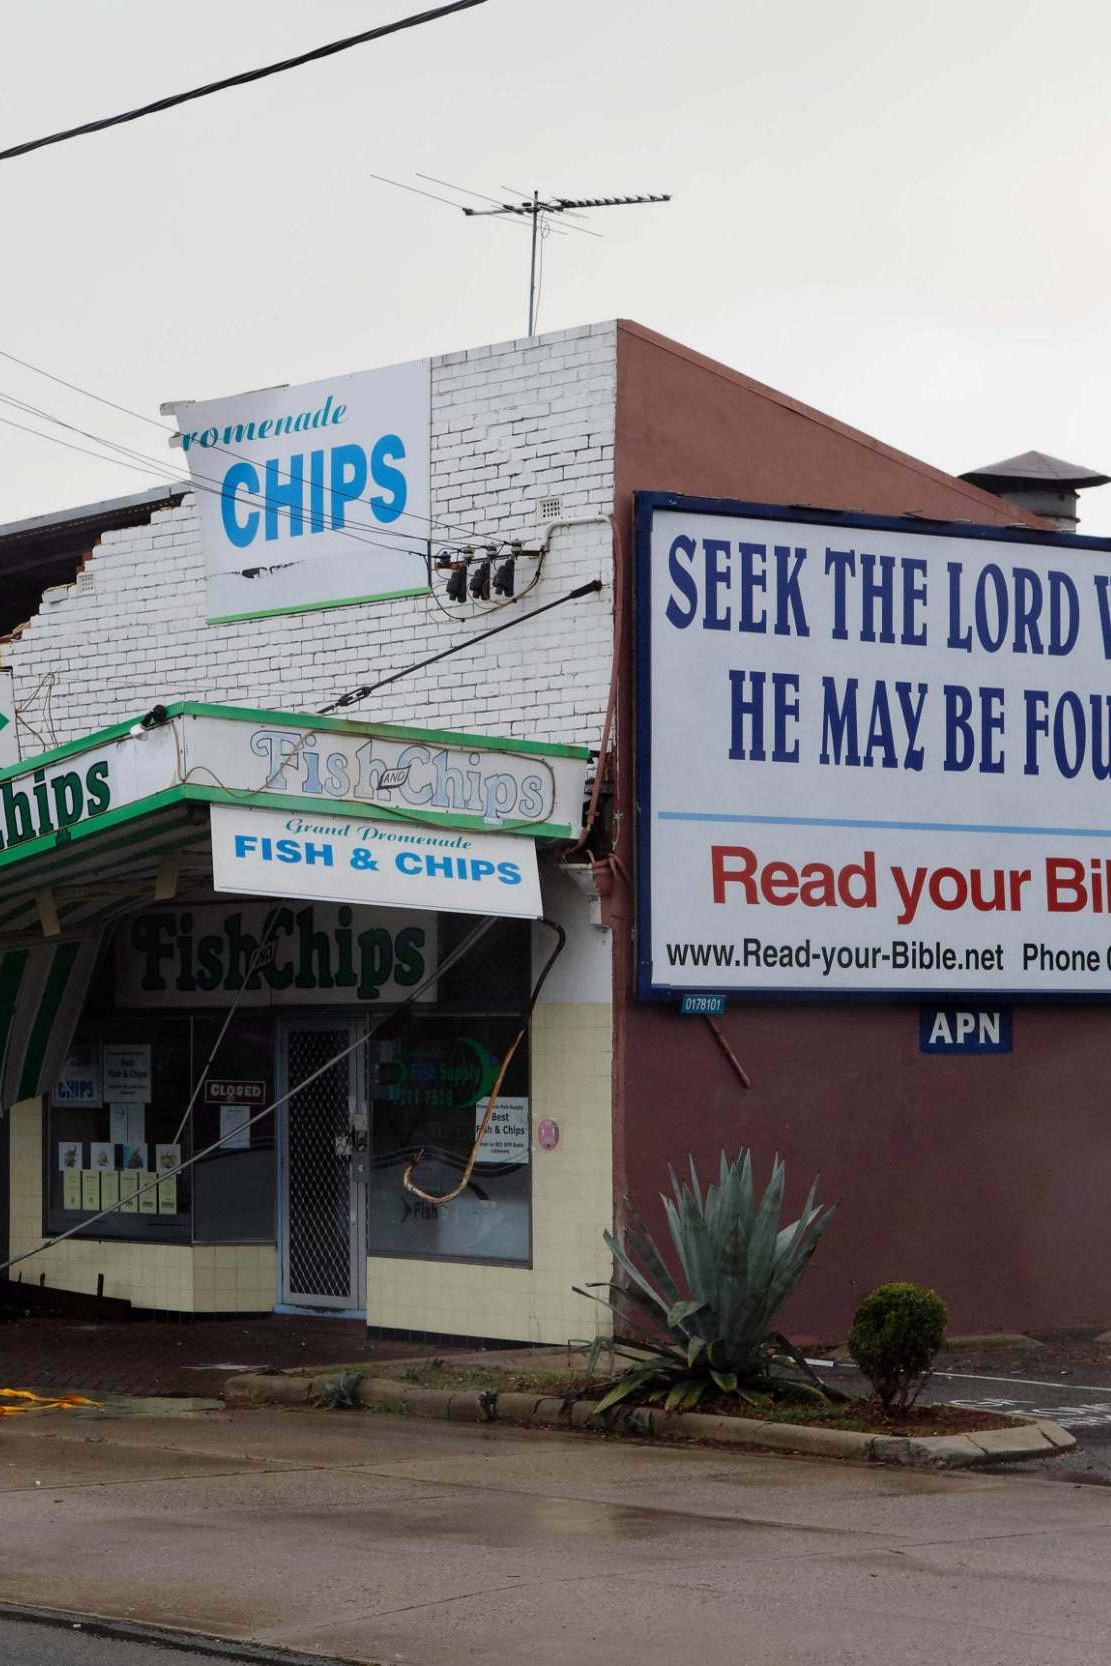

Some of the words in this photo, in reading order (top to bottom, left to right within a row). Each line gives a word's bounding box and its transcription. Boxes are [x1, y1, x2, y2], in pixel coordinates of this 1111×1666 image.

[221, 433, 408, 548] CHIPS
[665, 534, 810, 638] SEEK
[824, 547, 928, 647] THE
[946, 561, 1080, 657] LORD
[728, 669, 800, 764] HE
[818, 676, 929, 772] MAY
[943, 684, 1005, 774] BE
[250, 730, 392, 802] Fish
[383, 769, 408, 784] AND
[397, 745, 545, 825] Chips
[285, 818, 352, 838] Grand
[356, 824, 473, 850] Promenade
[234, 835, 334, 867] FISH
[349, 847, 381, 872] &
[395, 851, 523, 886] CHIPS
[711, 845, 878, 908] Read
[890, 866, 1032, 925] your
[132, 911, 262, 991] Fish
[264, 905, 426, 999] Chips
[666, 937, 1004, 976] www.Read-your-Bible.net
[1023, 943, 1101, 972] Phone
[685, 997, 722, 1012] 0178101
[928, 1012, 1001, 1045] APN
[210, 1083, 261, 1097] CLOSED
[491, 1112, 510, 1122] Best
[494, 1125, 501, 1134] &
[503, 1125, 526, 1136] Chips
[413, 1201, 438, 1220] Fish
